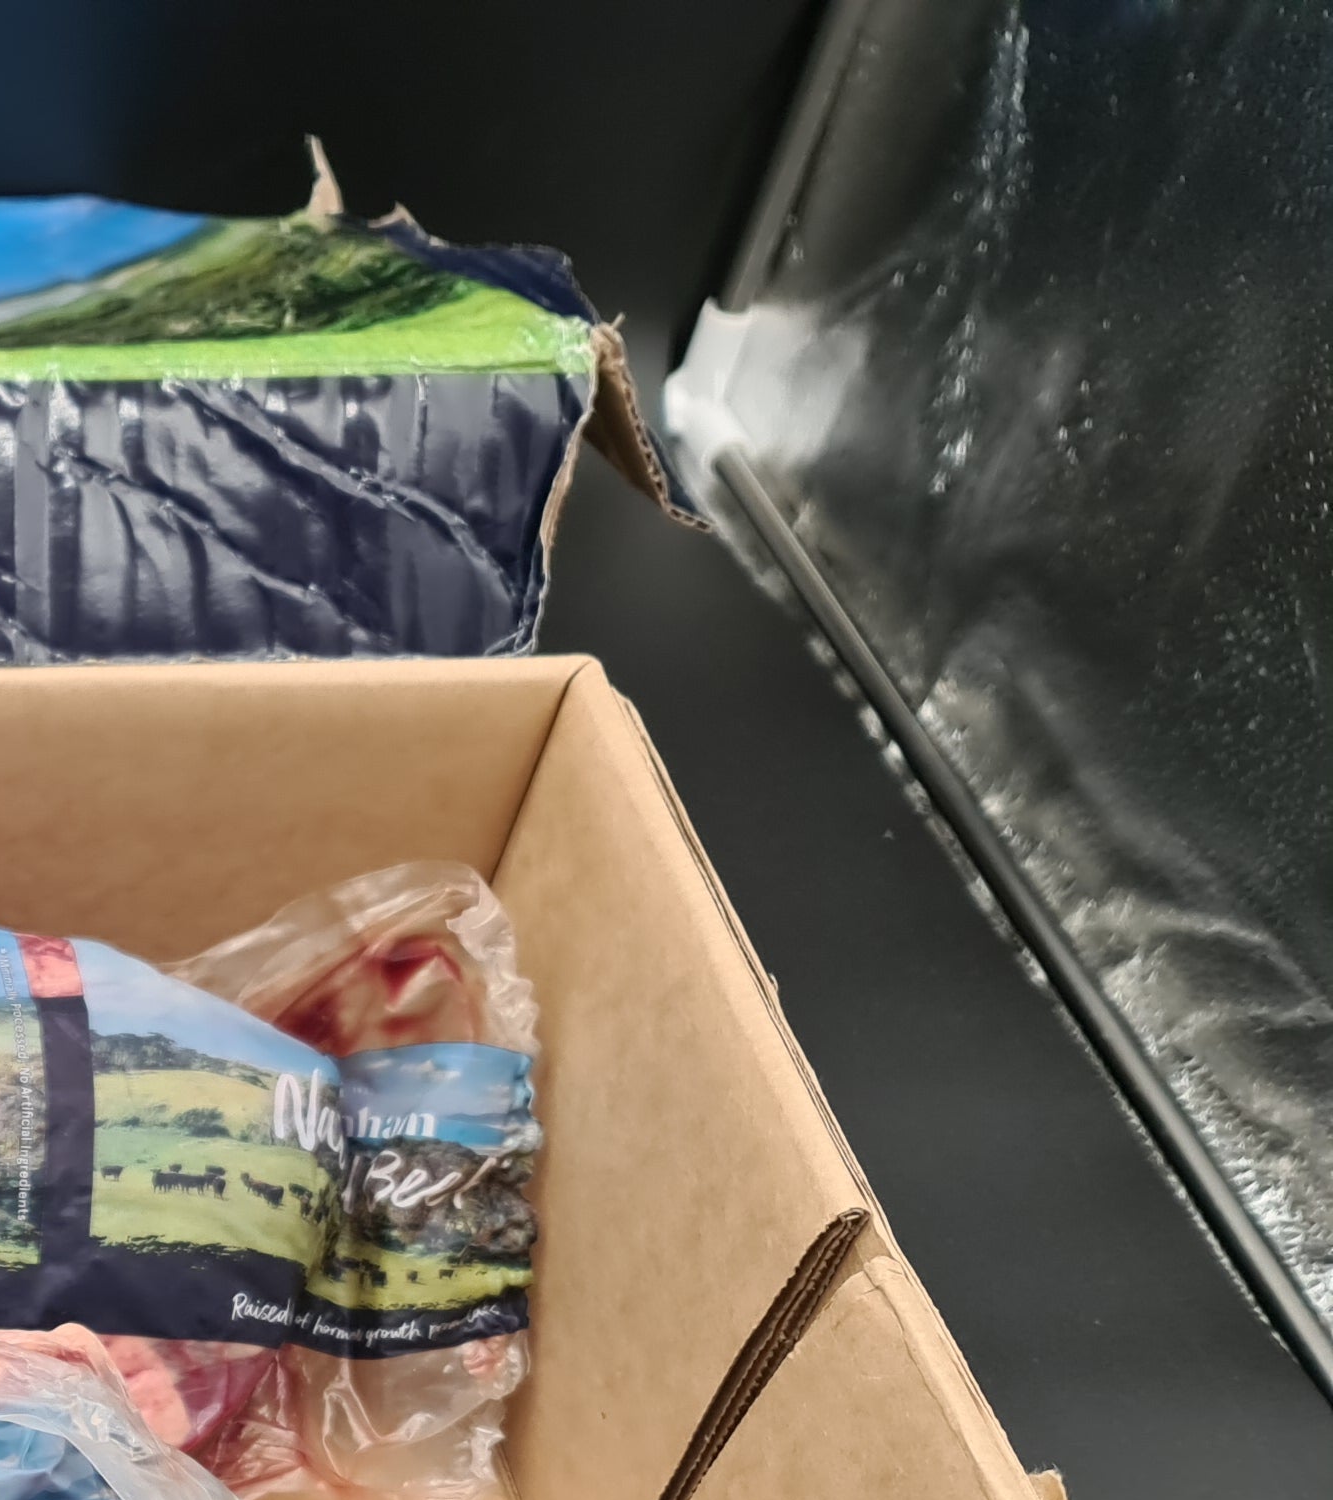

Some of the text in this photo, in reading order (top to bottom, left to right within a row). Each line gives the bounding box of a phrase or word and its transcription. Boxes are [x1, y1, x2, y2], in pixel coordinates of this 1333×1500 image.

[20, 1067, 31, 1083] No
[21, 1087, 33, 1141] Artificial
[17, 1145, 31, 1221] Ingredients
[365, 1321, 421, 1347] growth
